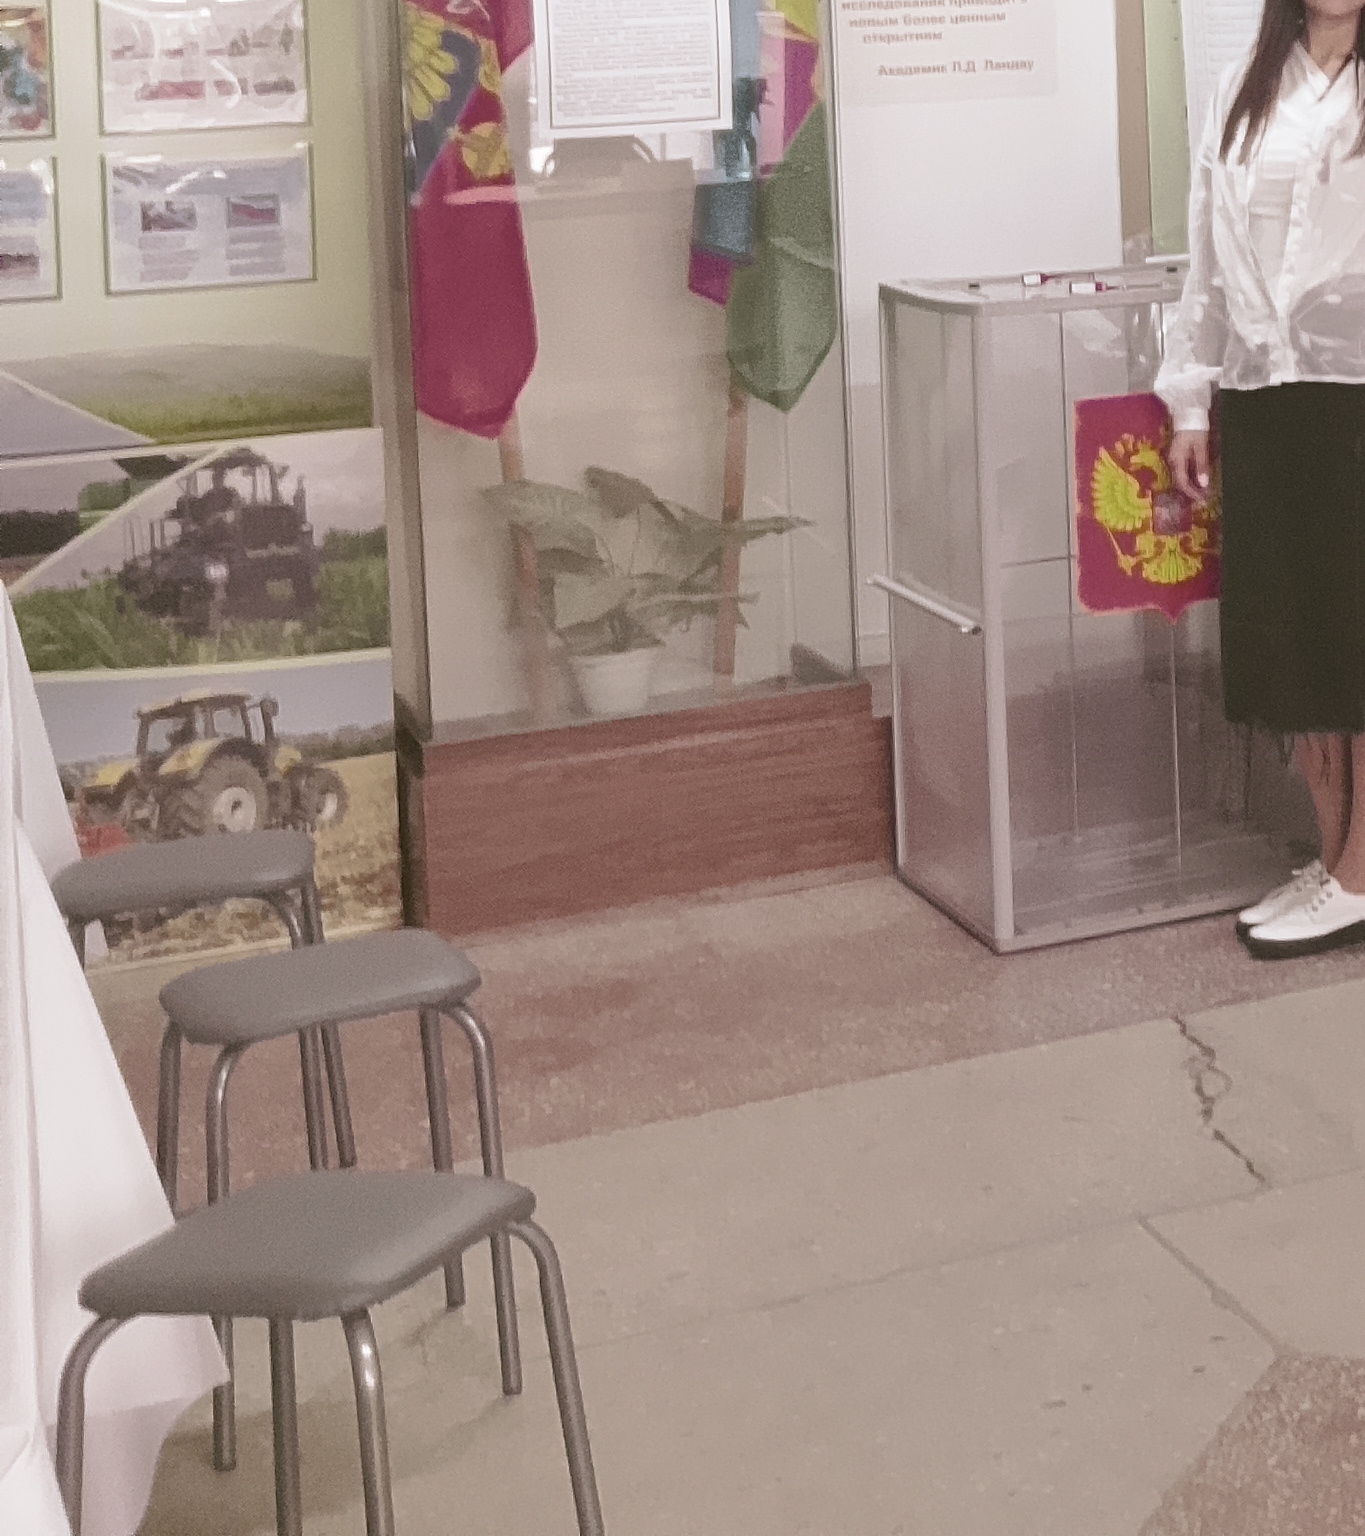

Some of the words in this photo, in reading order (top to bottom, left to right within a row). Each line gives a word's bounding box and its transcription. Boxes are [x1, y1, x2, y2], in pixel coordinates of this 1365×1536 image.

[849, 16, 899, 28] новым
[902, 13, 946, 26] более
[949, 12, 1006, 25] ценным
[878, 63, 948, 76] Академик
